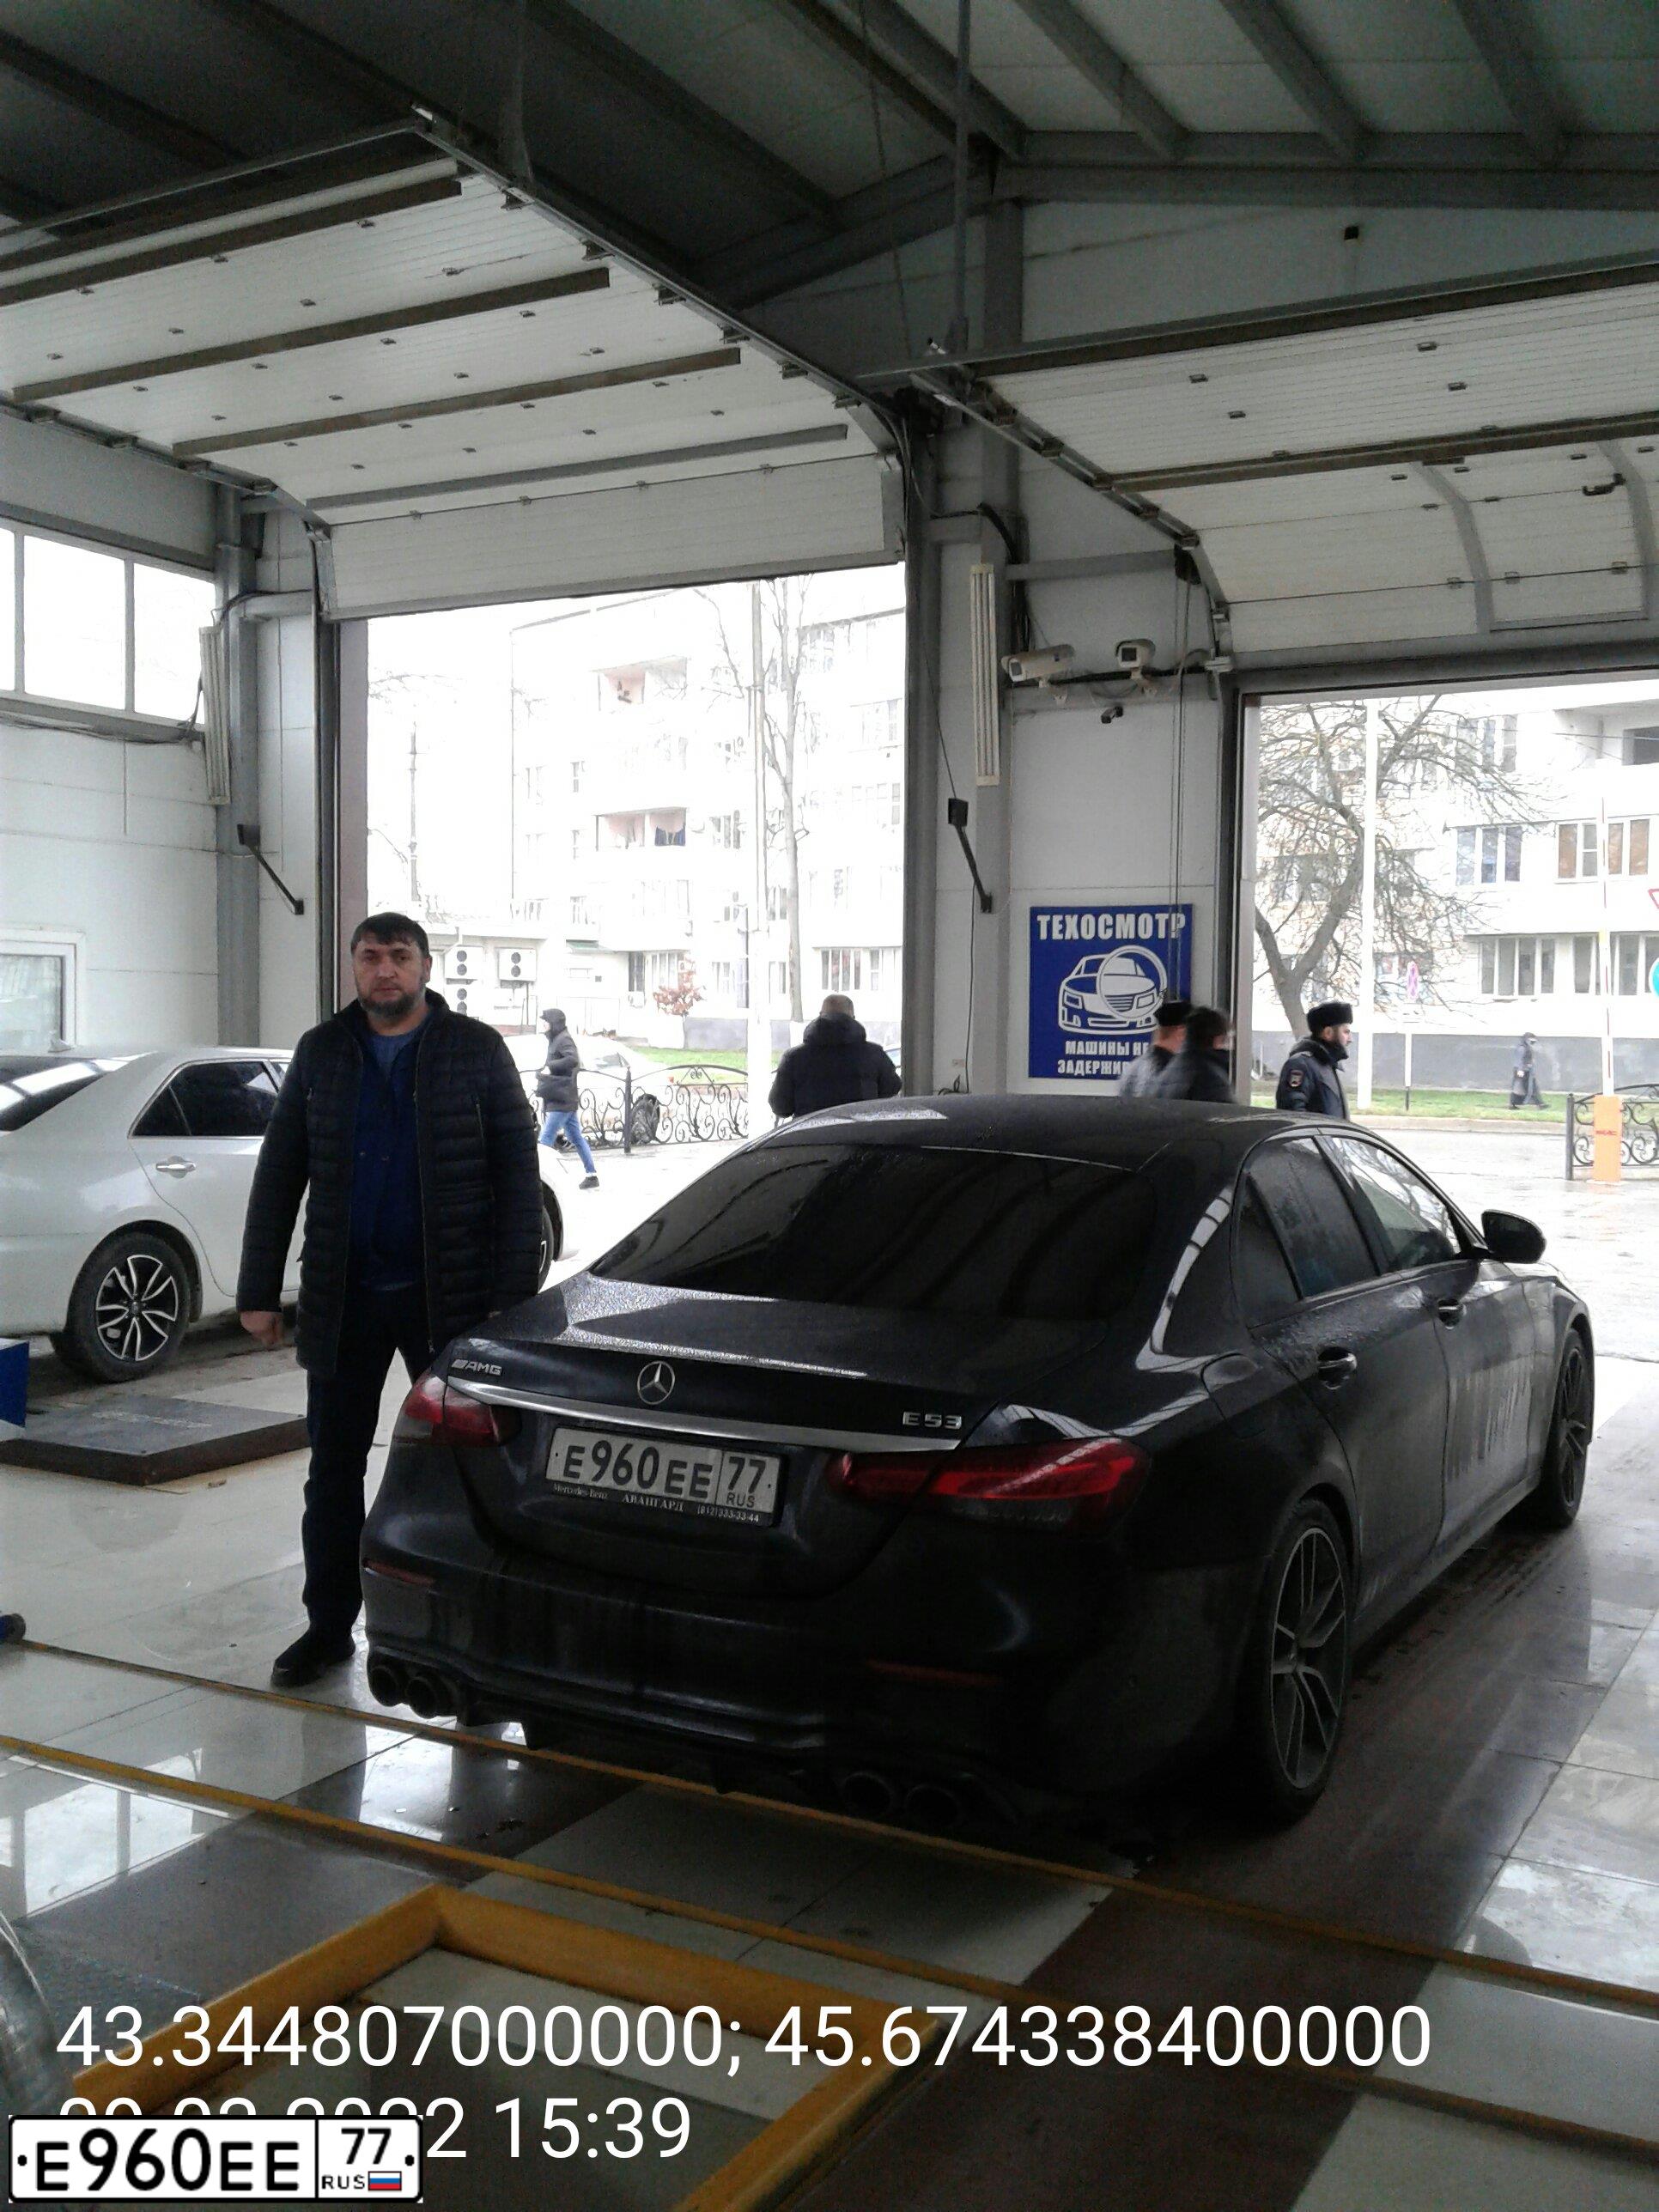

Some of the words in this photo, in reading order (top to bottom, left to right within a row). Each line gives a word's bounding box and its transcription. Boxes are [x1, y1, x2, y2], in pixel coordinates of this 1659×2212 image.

[1036, 913, 1186, 940] ТЕХОСМОТР
[1065, 1040, 1130, 1056] МАШИНЫ
[465, 1361, 502, 1376] AMG
[562, 1439, 714, 1499] Е960ЕЕ
[727, 1456, 766, 1495] 77
[726, 1492, 756, 1509] RUS
